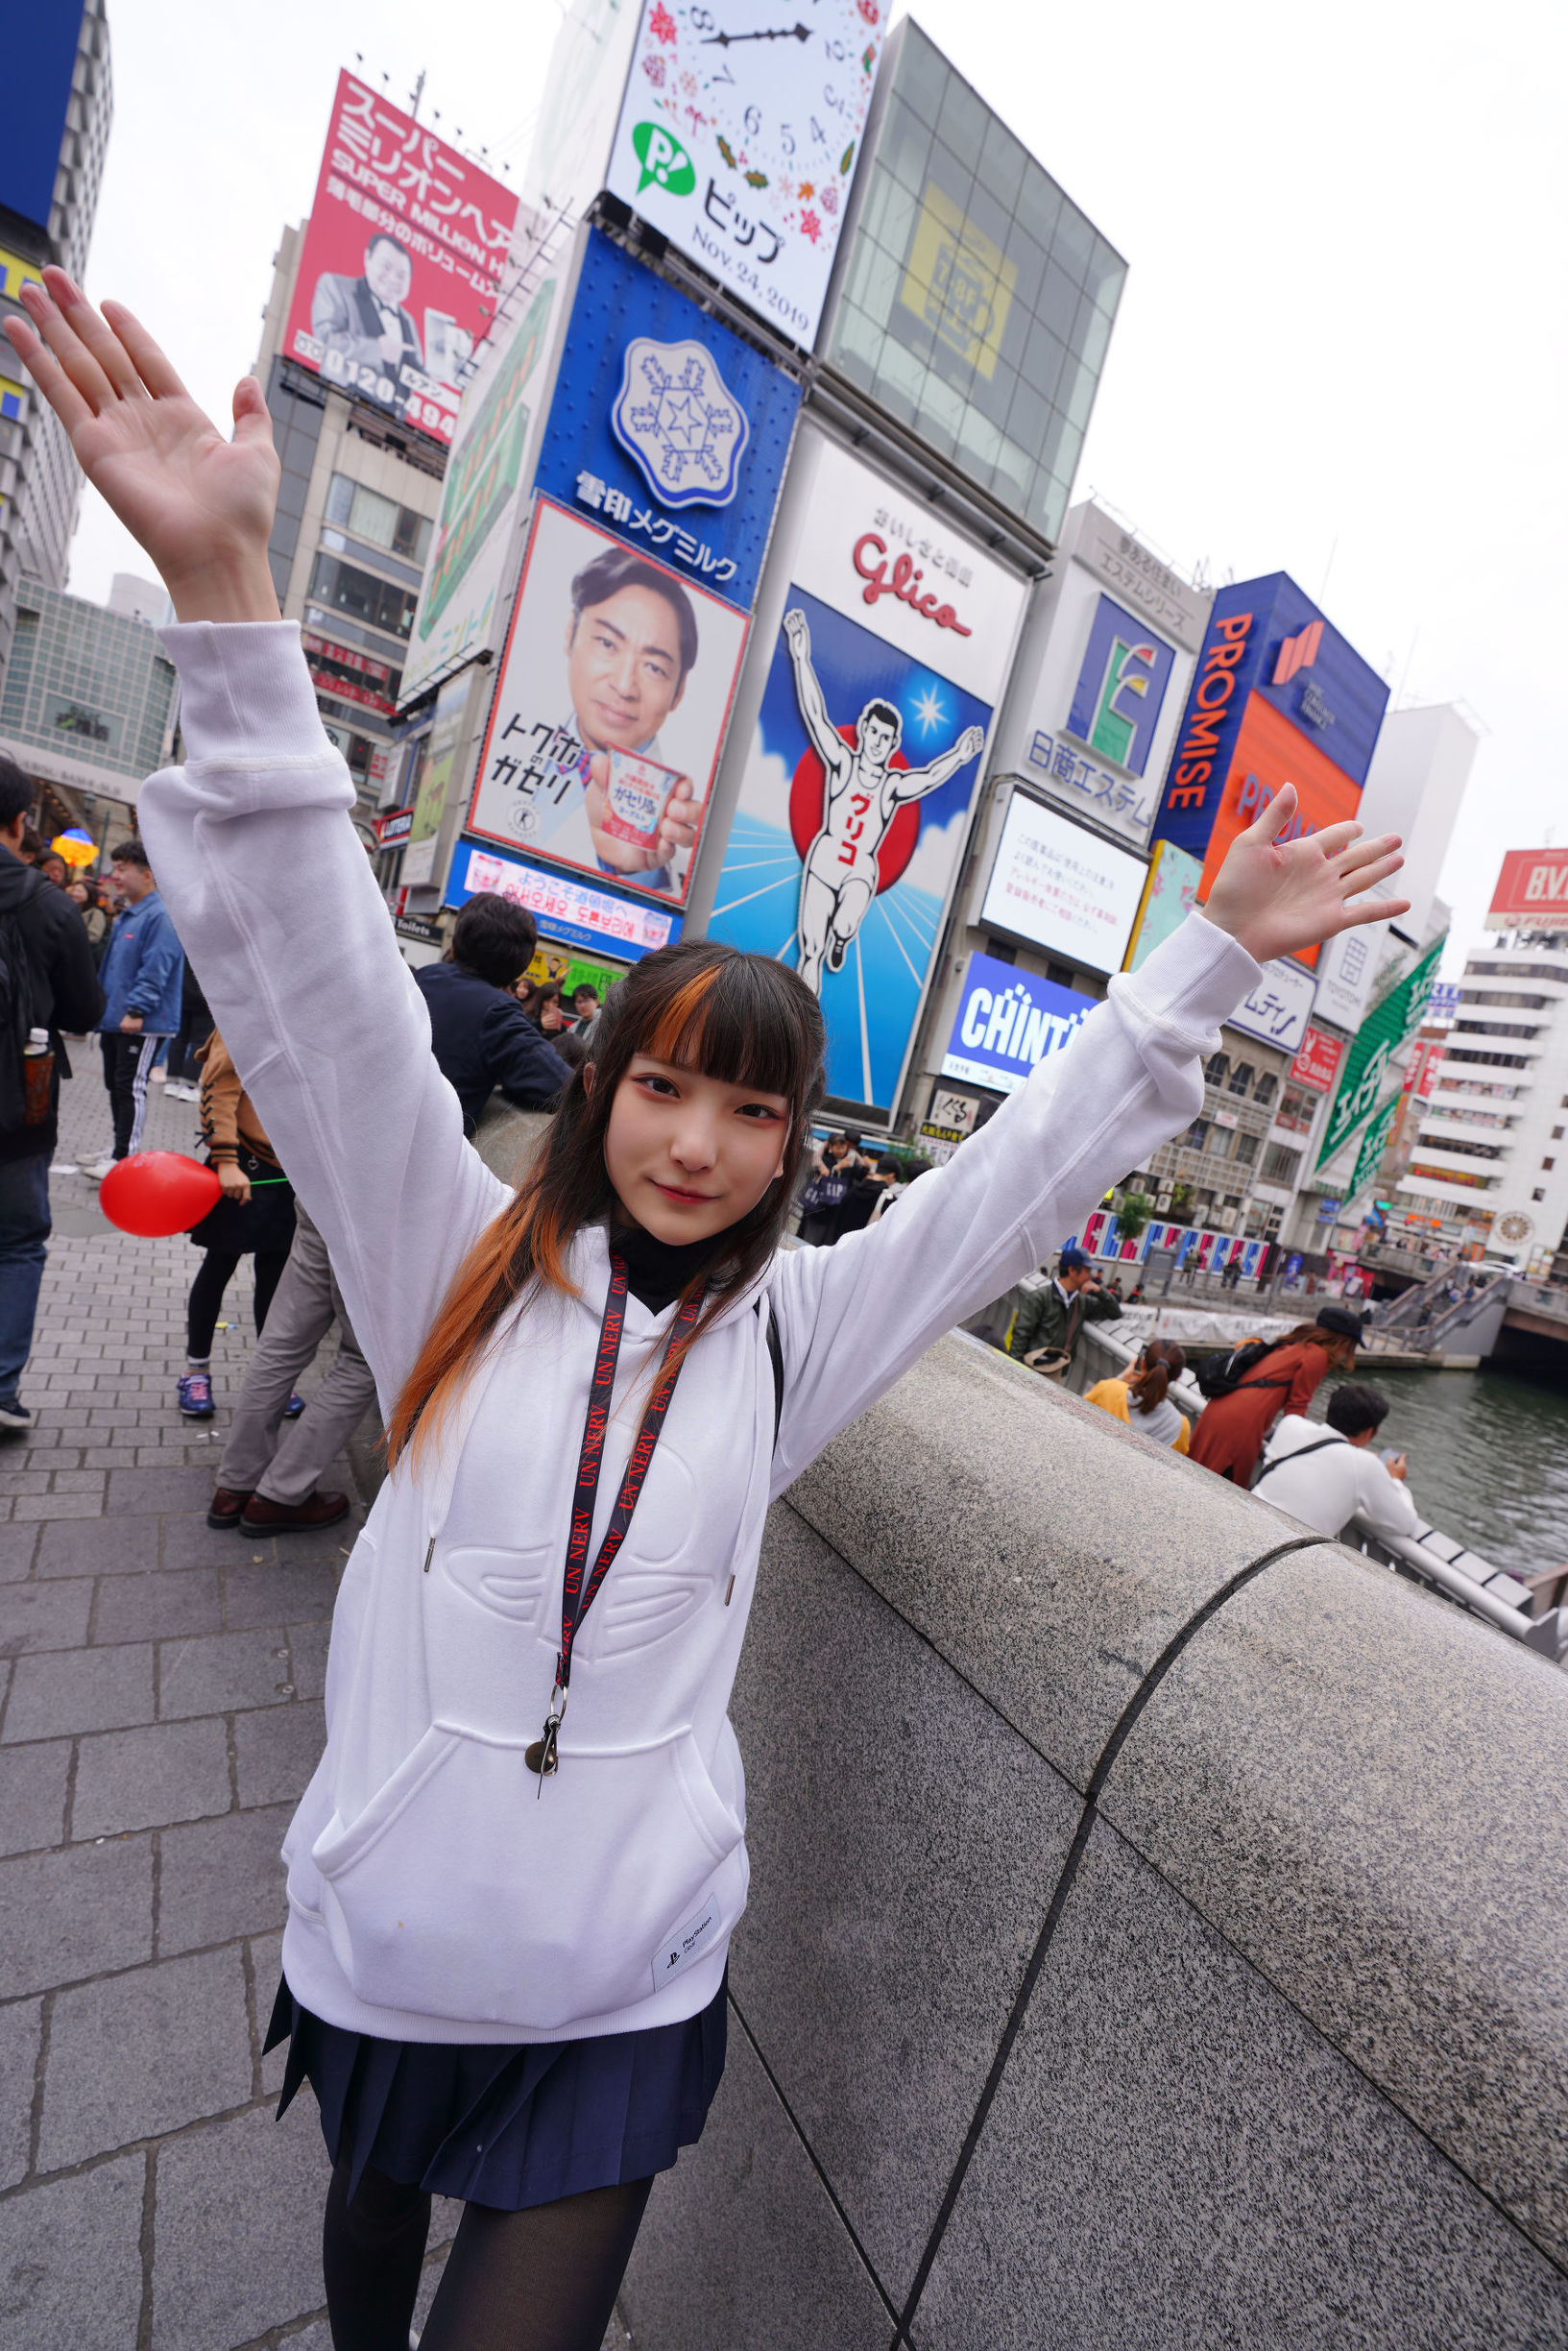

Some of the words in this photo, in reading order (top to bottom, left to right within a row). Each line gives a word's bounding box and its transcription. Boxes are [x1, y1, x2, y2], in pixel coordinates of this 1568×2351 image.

[342, 80, 466, 182] スーパー
[744, 105, 761, 135] 6
[780, 124, 796, 155] 5
[809, 115, 826, 144] 4
[337, 112, 513, 250] ミリオンヘア
[330, 148, 407, 211] SUPER
[409, 201, 486, 266] MILLION
[704, 177, 785, 264] ピップ
[765, 286, 809, 333] 2019
[576, 469, 738, 581] 雪印メグミルク
[854, 532, 973, 637] Glico
[1167, 613, 1253, 809] PROMISE
[500, 712, 581, 765] トクホ
[491, 754, 572, 805] ガセリ
[1029, 728, 1152, 829] 日商エステム
[838, 791, 874, 866] グリコ
[398, 920, 430, 936] Toilets
[601, 1308, 622, 1354] NERV
[594, 1358, 612, 1386] UN
[651, 1387, 671, 1413] UN
[585, 1404, 607, 1455] NERV
[628, 1428, 658, 1480] NERV
[579, 1459, 596, 1488] UN
[619, 1480, 639, 1511] UN
[569, 1508, 591, 1562] NERV
[594, 1528, 624, 1581] NERV
[566, 1566, 582, 1595] UN
[682, 1916, 712, 1948] PlayStation
